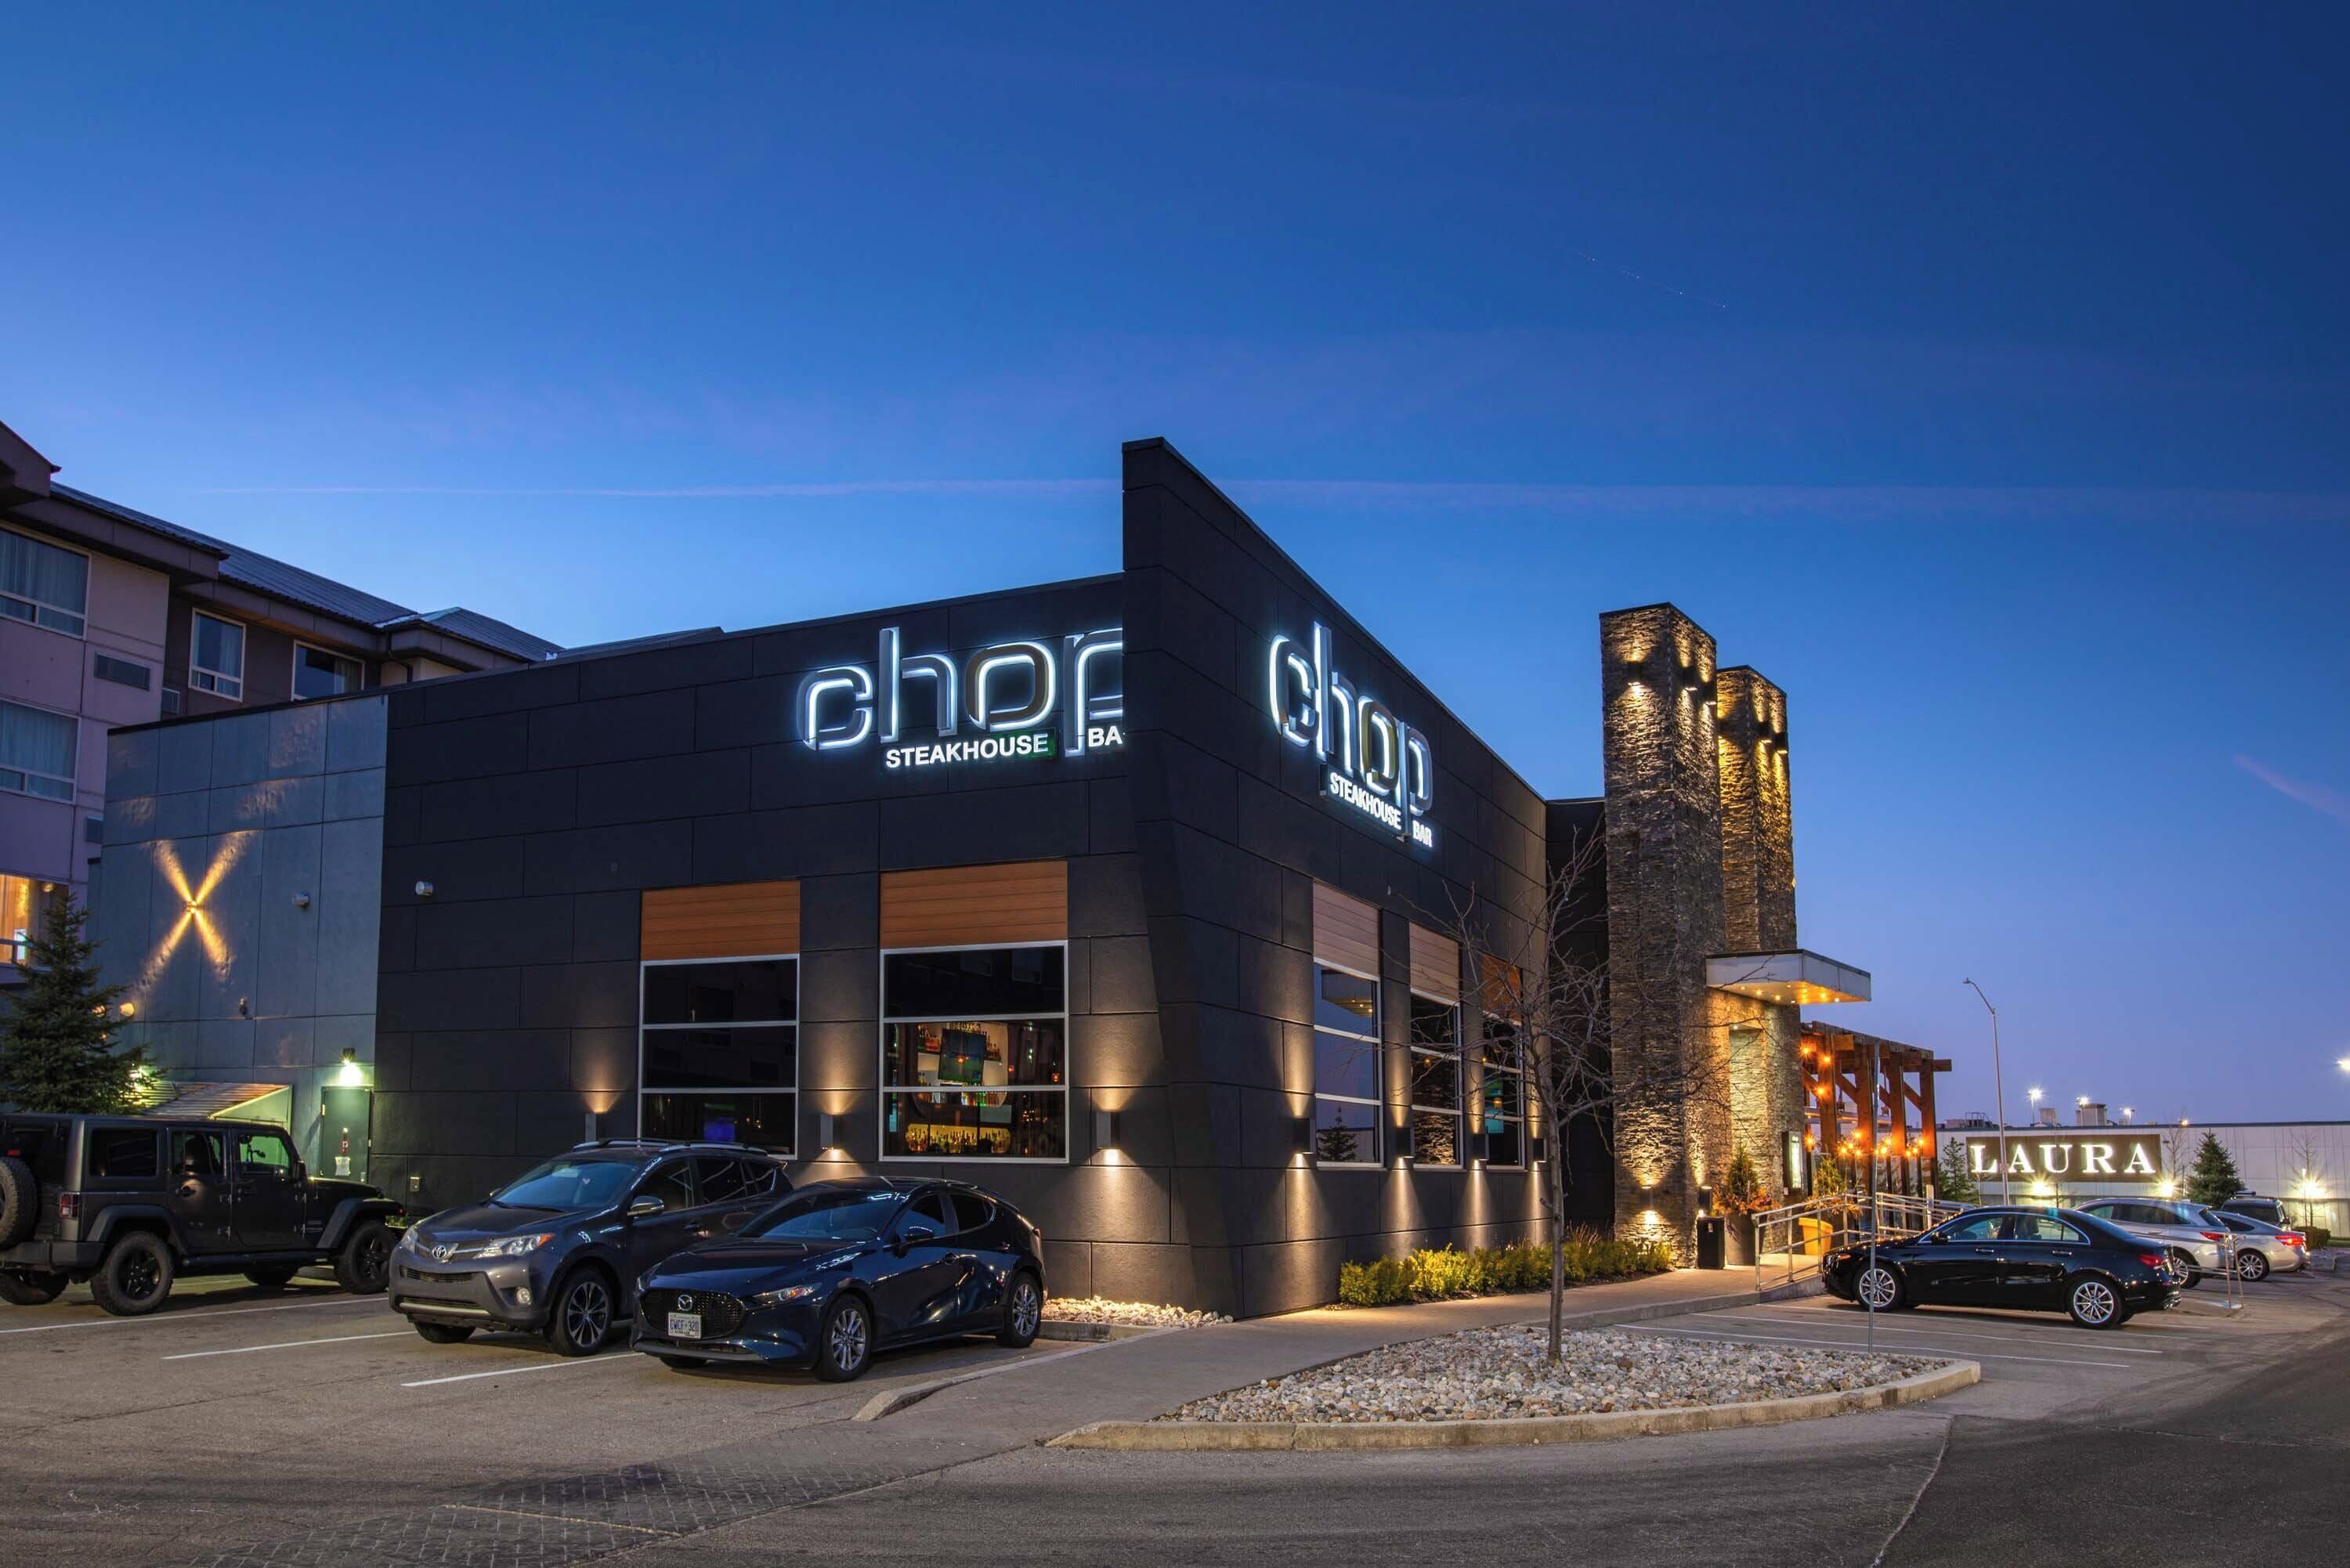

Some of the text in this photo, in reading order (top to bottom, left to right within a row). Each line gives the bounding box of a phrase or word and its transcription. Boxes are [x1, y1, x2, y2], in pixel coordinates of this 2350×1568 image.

[885, 725, 1123, 768] STEAKHOUSE BA
[1269, 621, 1433, 842] chop
[1330, 772, 1433, 848] STEAKHOUSE BAR
[1970, 1143, 2156, 1173] LAURA
